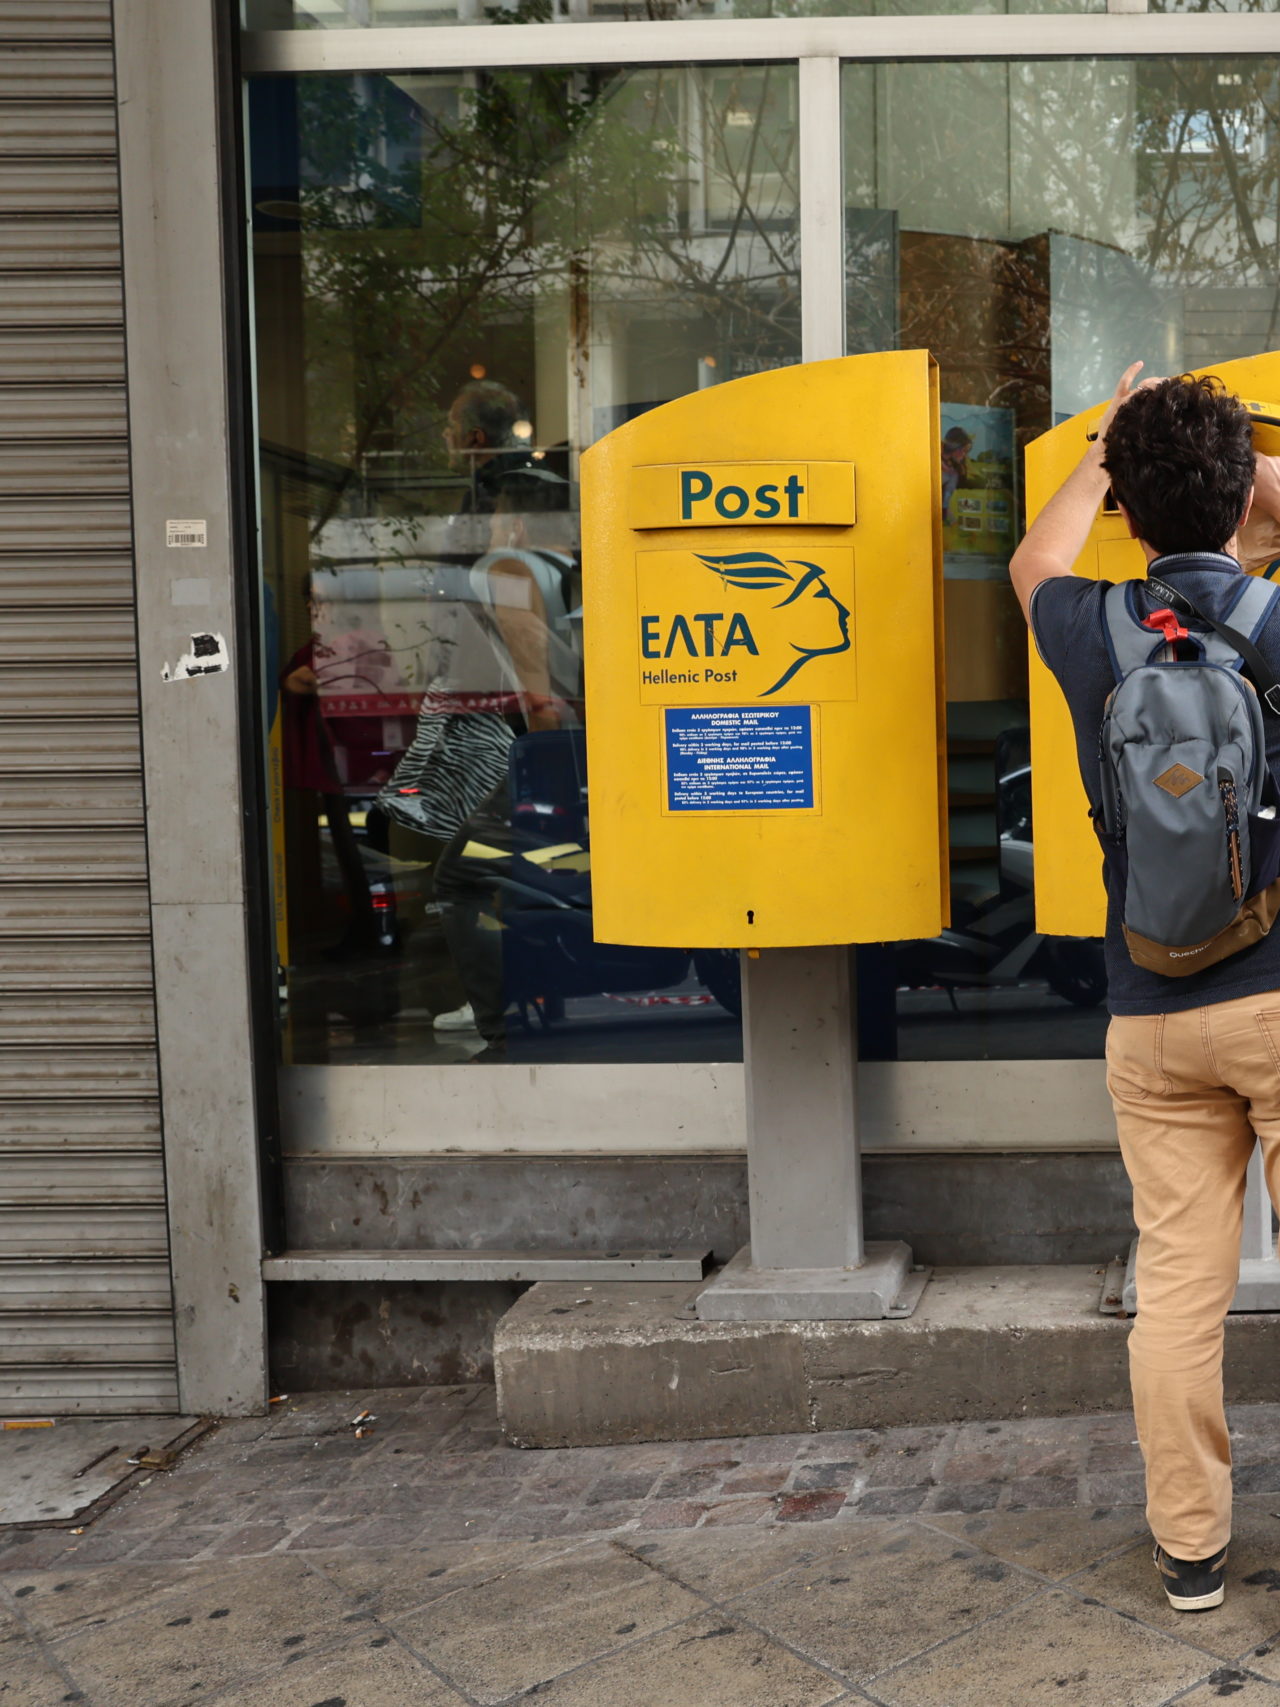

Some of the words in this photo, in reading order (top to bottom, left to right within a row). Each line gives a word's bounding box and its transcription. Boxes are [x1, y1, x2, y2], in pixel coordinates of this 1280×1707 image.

[681, 470, 805, 520] Post
[641, 613, 760, 659] ΕΛΤΑ
[642, 668, 701, 685] Hellenic
[704, 669, 738, 684] Post
